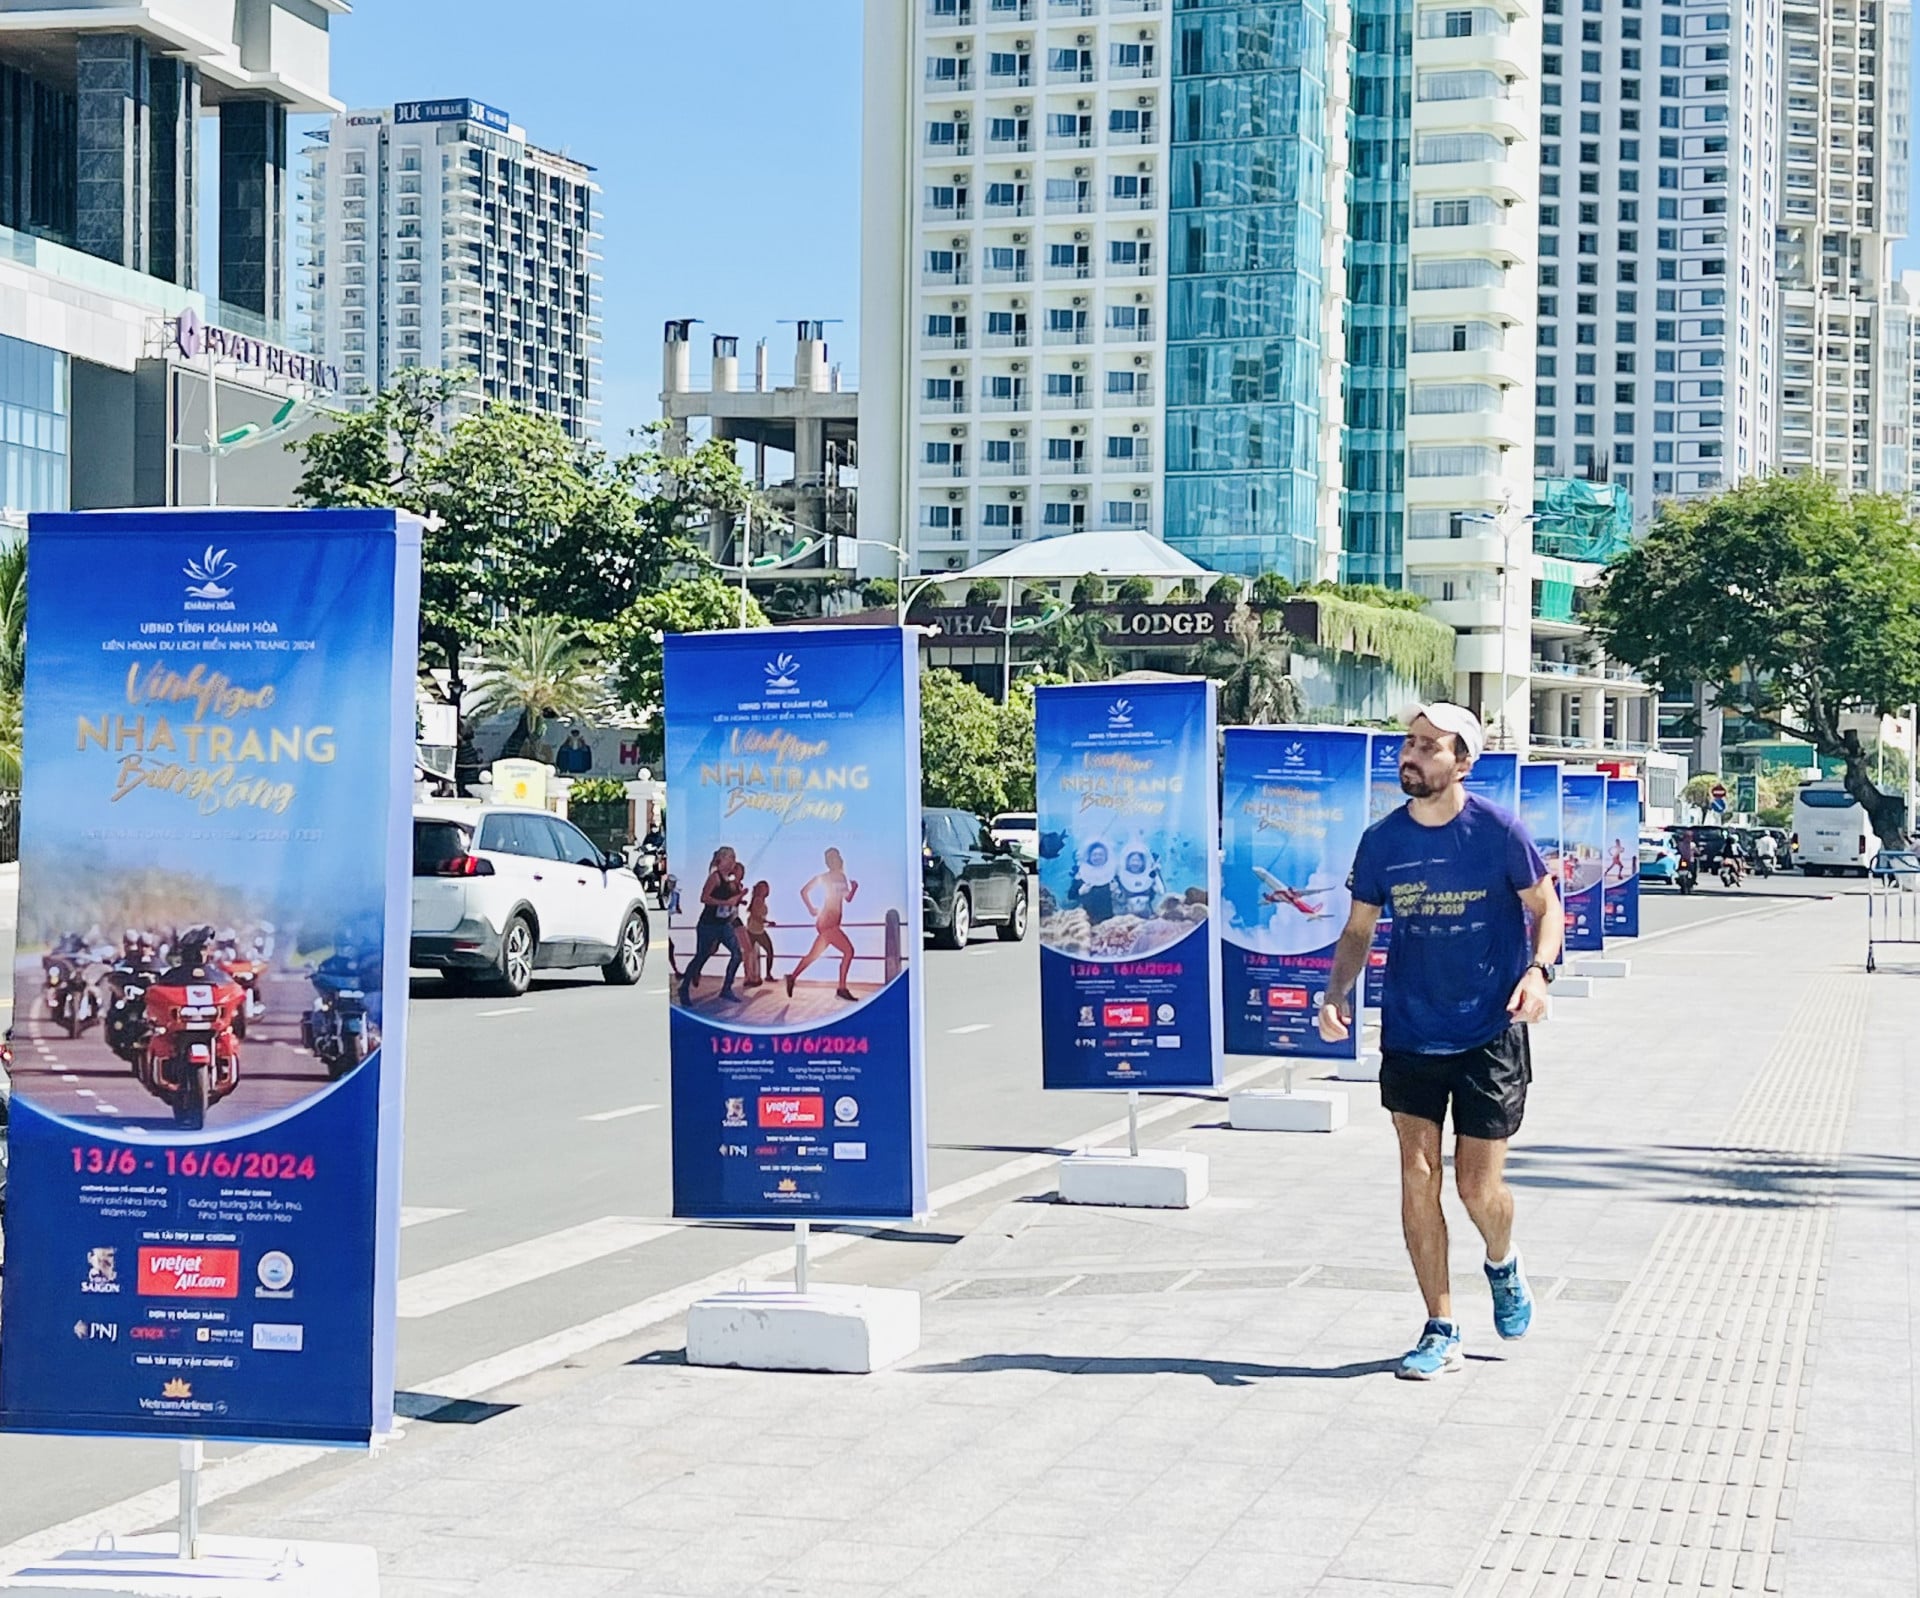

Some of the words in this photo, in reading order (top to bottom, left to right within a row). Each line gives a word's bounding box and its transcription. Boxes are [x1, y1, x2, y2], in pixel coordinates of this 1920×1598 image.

[266, 345, 341, 391] REGENCY
[140, 622, 174, 634] UBND
[208, 620, 248, 633] KHÁNH
[252, 620, 278, 633] HÒA
[1115, 612, 1214, 636] LODGE
[127, 641, 157, 650] HOAN
[229, 640, 250, 650] NHA
[254, 640, 289, 651] TRANG
[76, 715, 177, 752] NHA
[181, 725, 336, 764] TRANG
[700, 761, 765, 786] NHA
[768, 765, 869, 791] TRANG
[710, 1037, 753, 1054] 13/6
[771, 1036, 869, 1054] 16/6/2024
[71, 1147, 137, 1175] 13/6
[165, 1150, 316, 1180] 16/6/2024
[89, 1323, 118, 1342] PNJ
[139, 1398, 179, 1409] Vietnam
